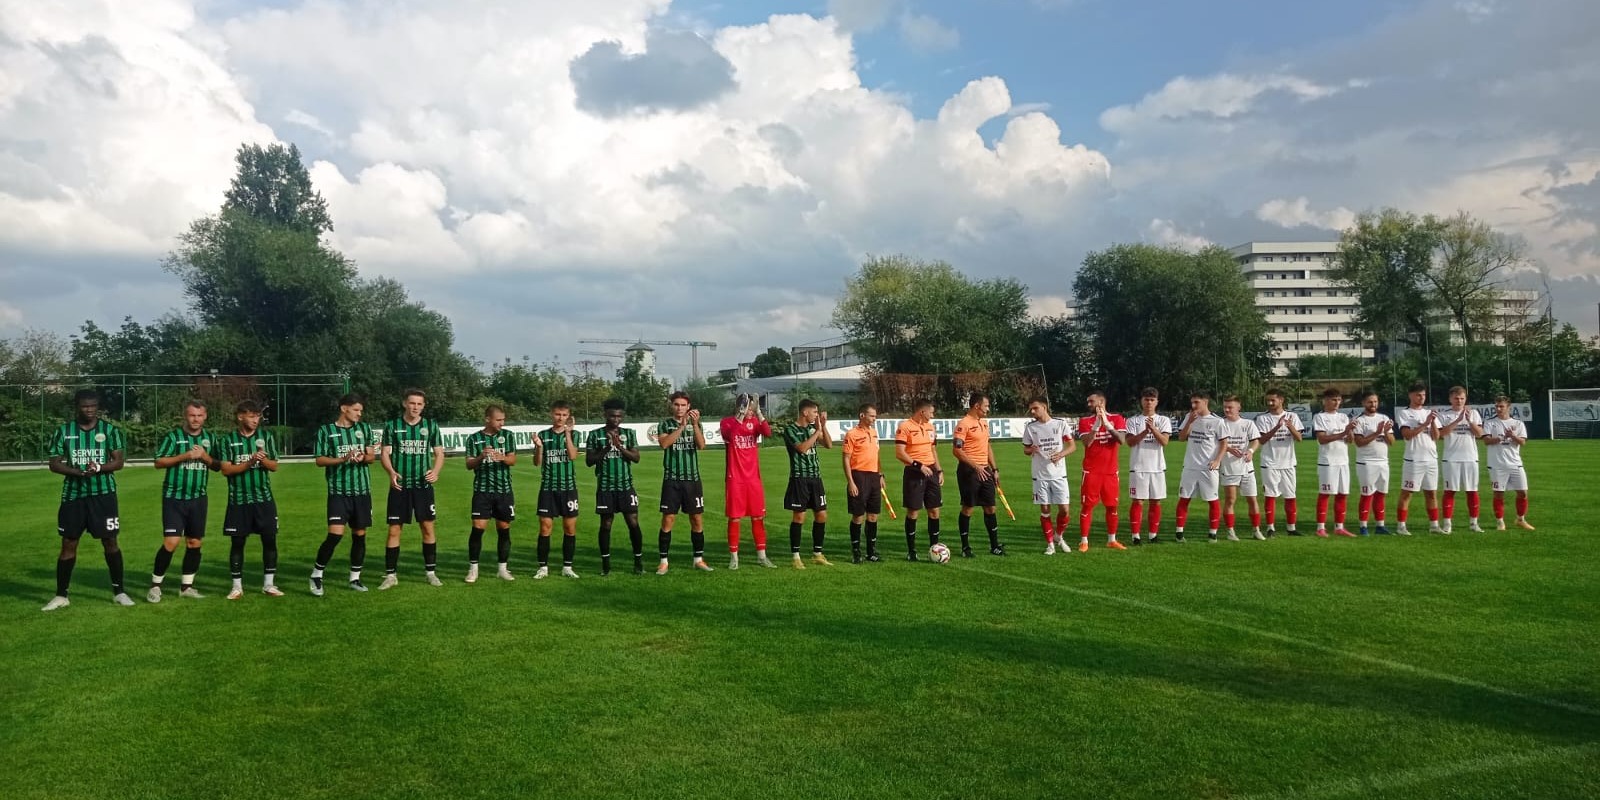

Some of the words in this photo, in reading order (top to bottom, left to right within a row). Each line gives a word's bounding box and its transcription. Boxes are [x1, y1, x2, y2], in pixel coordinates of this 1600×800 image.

[72, 449, 105, 457] SERVICII
[567, 500, 579, 511] 96
[106, 517, 120, 530] 55
